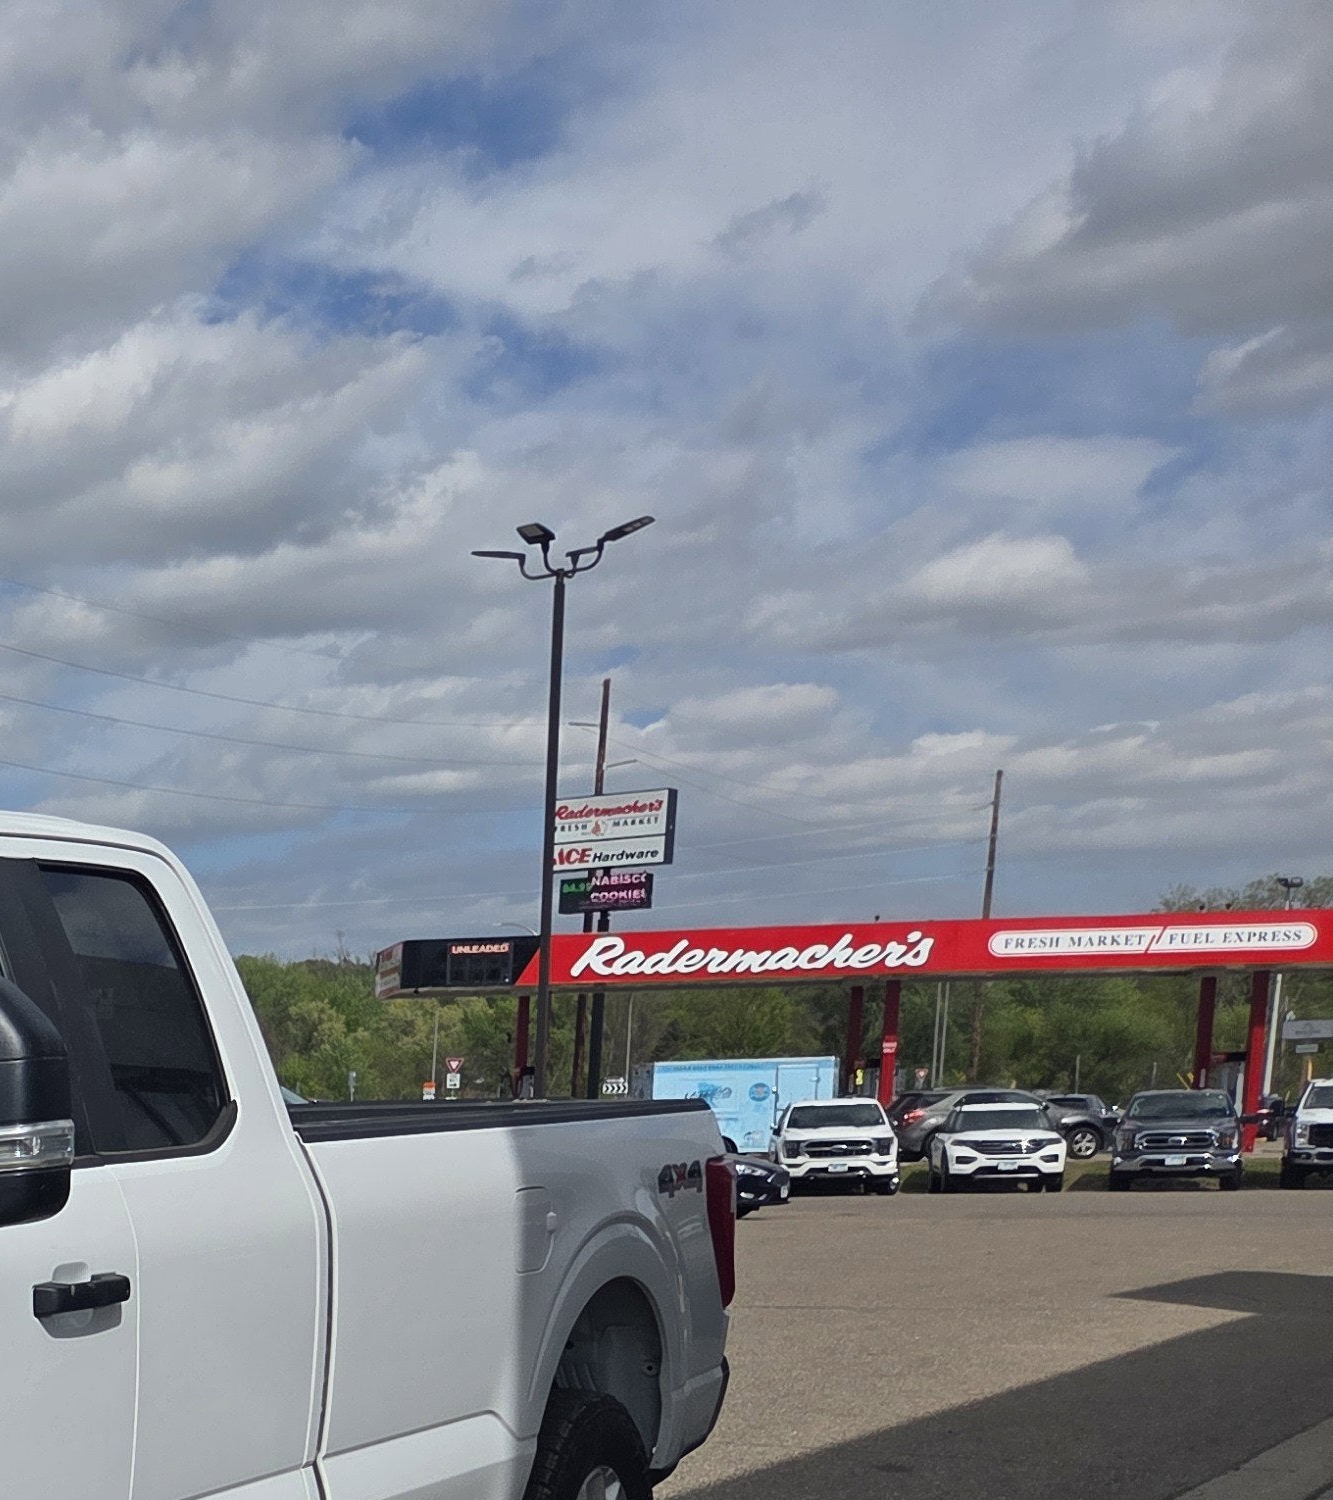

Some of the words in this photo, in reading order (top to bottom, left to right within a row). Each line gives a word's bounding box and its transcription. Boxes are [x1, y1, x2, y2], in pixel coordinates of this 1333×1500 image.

[555, 799, 664, 820] Radermacher's
[612, 817, 659, 827] MARKET
[593, 850, 659, 863] Hardware
[1004, 936, 1060, 949] FRESH
[1067, 934, 1146, 948] MARKET
[1169, 932, 1215, 945] FUEL
[1222, 930, 1303, 944] EXPRESS
[570, 931, 934, 977] Radermacher's
